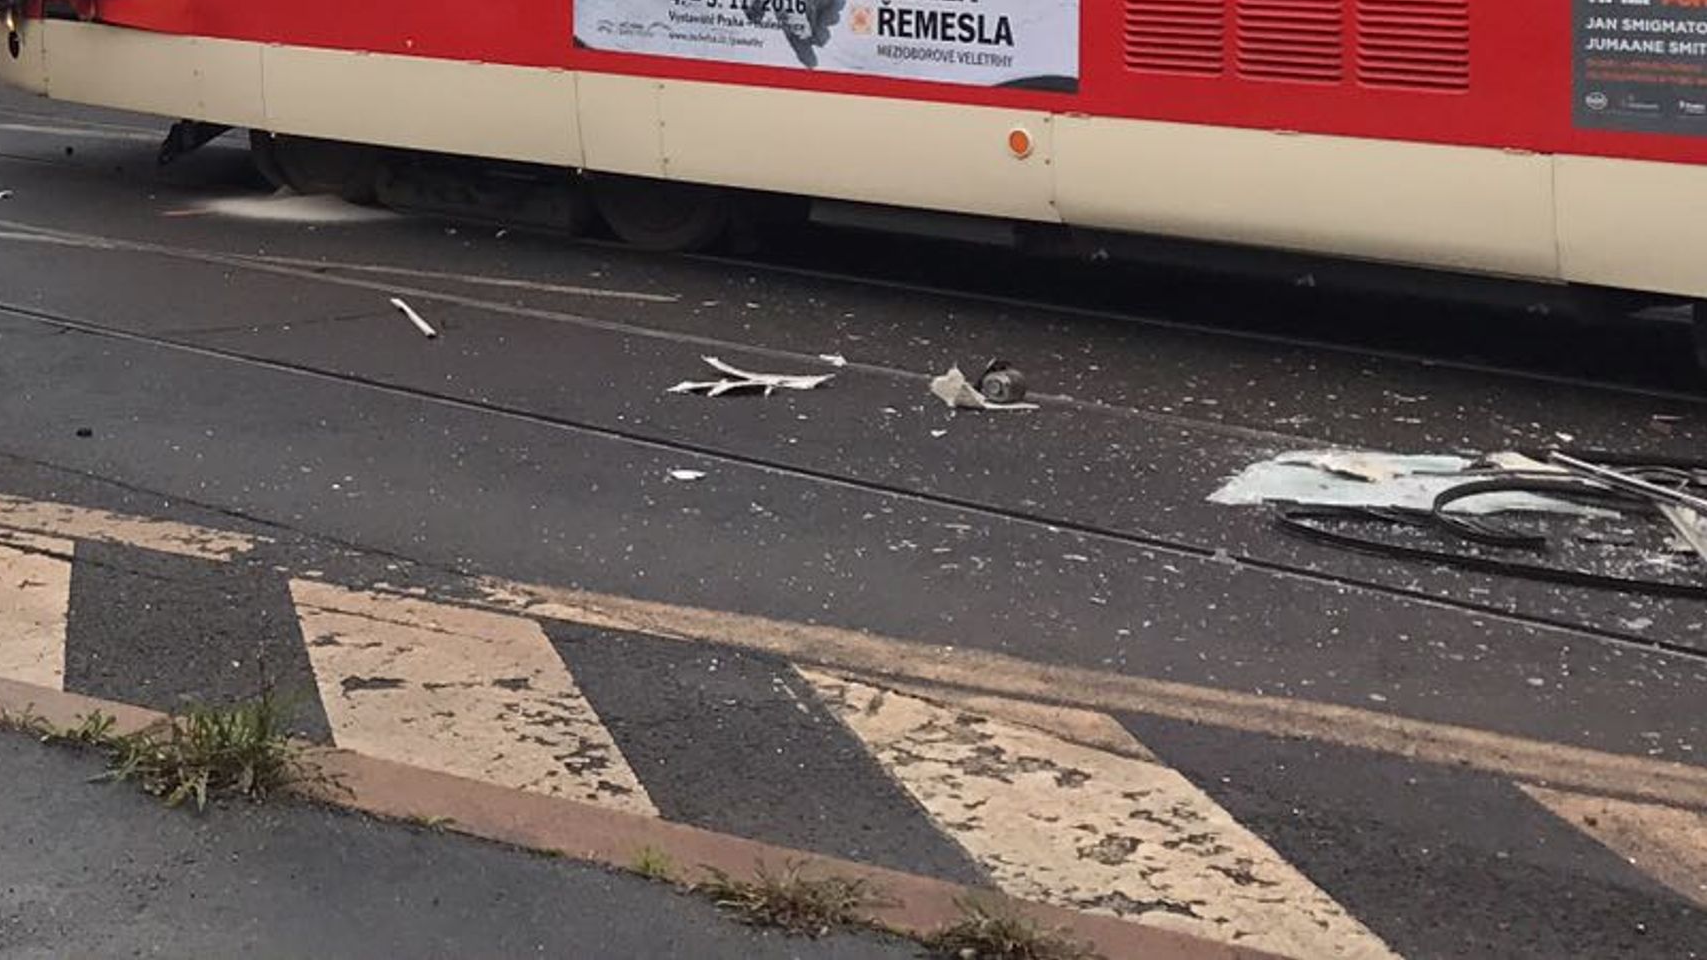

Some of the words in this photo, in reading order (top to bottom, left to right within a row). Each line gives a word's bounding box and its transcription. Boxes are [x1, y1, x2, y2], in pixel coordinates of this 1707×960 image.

[877, 0, 1014, 46] ŘEMESLA
[1586, 17, 1618, 31] JAN
[1586, 38, 1664, 53] JUMAANE
